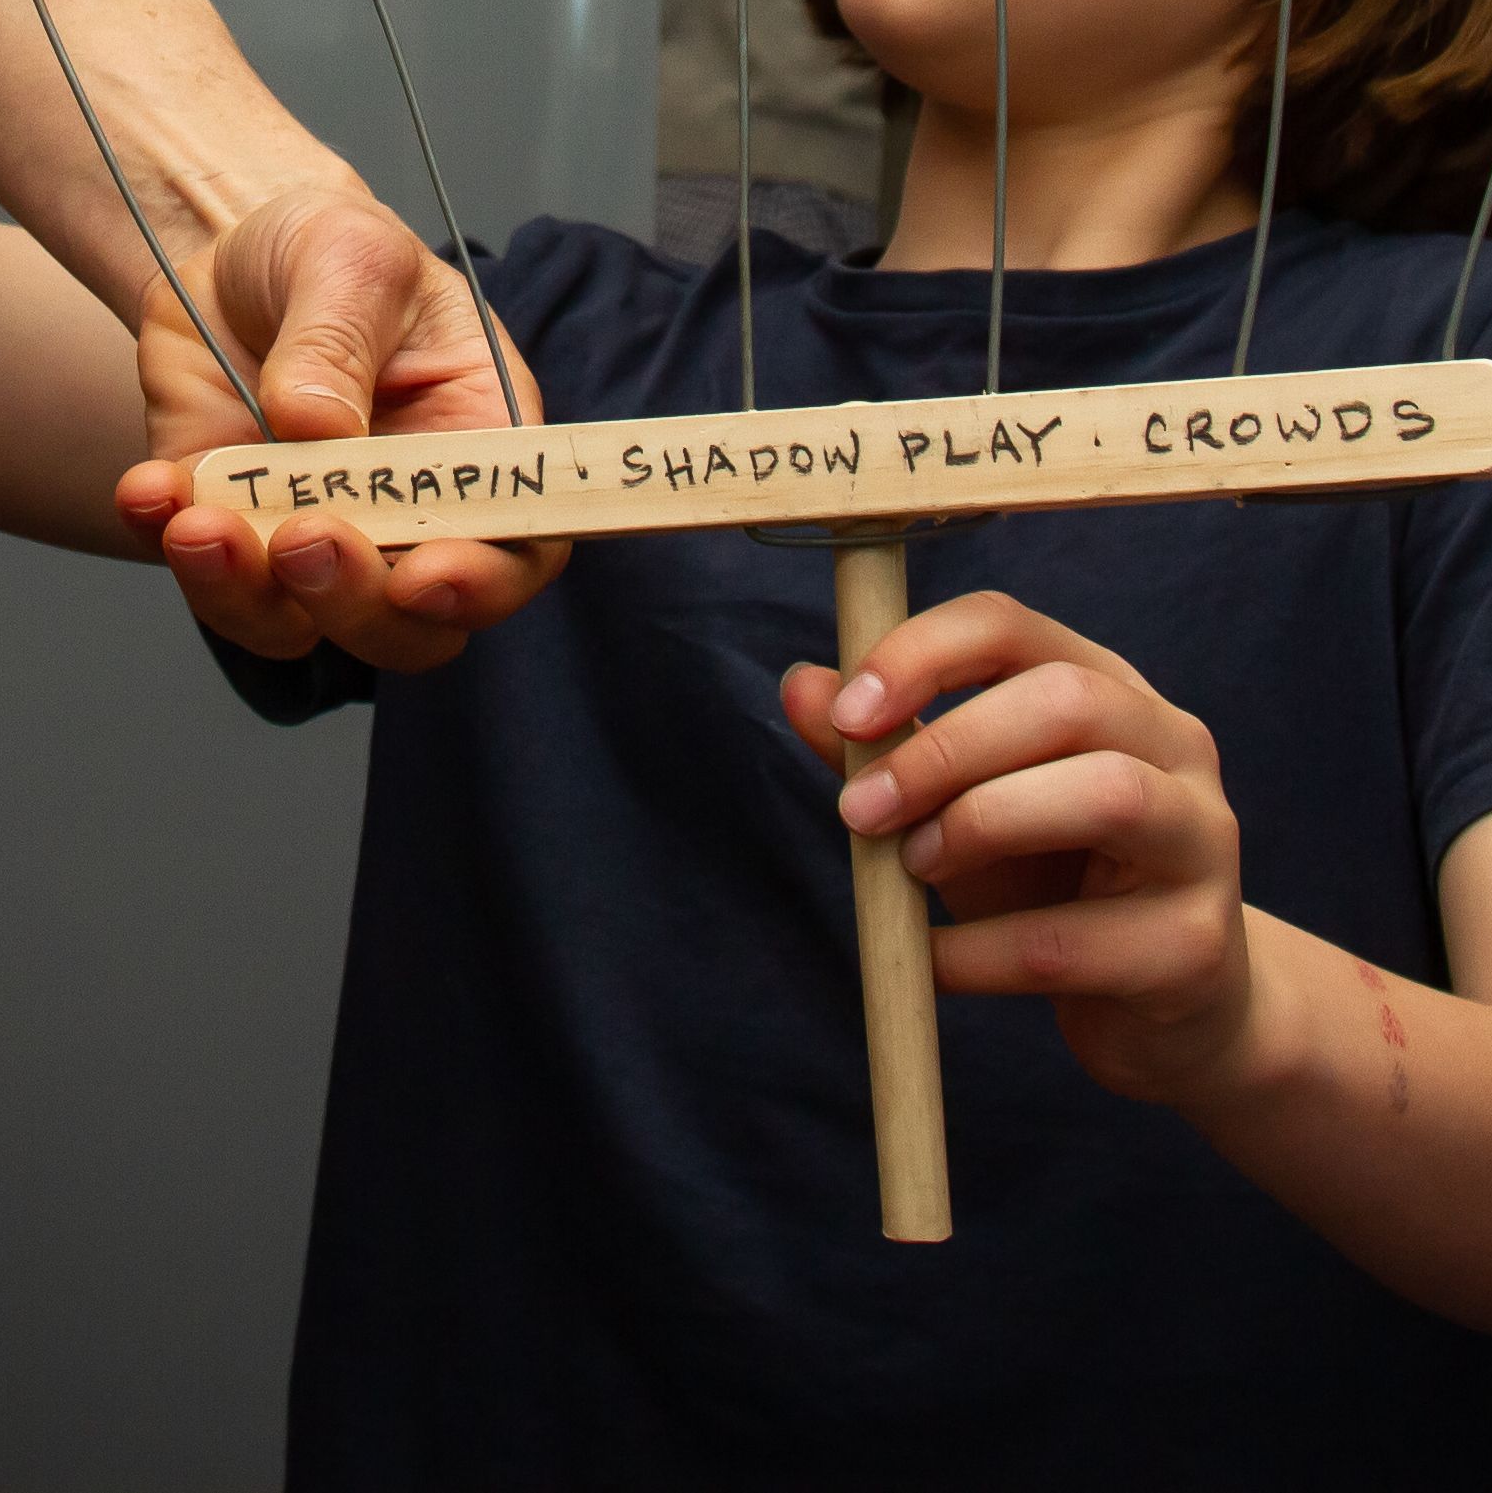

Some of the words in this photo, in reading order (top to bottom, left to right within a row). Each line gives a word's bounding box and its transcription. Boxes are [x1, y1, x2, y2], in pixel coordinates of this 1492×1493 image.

[227, 451, 546, 510] TERRAPIN
[621, 428, 861, 492] SHADOW
[897, 416, 1063, 473] PLAY
[1143, 398, 1436, 455] CROWDS
